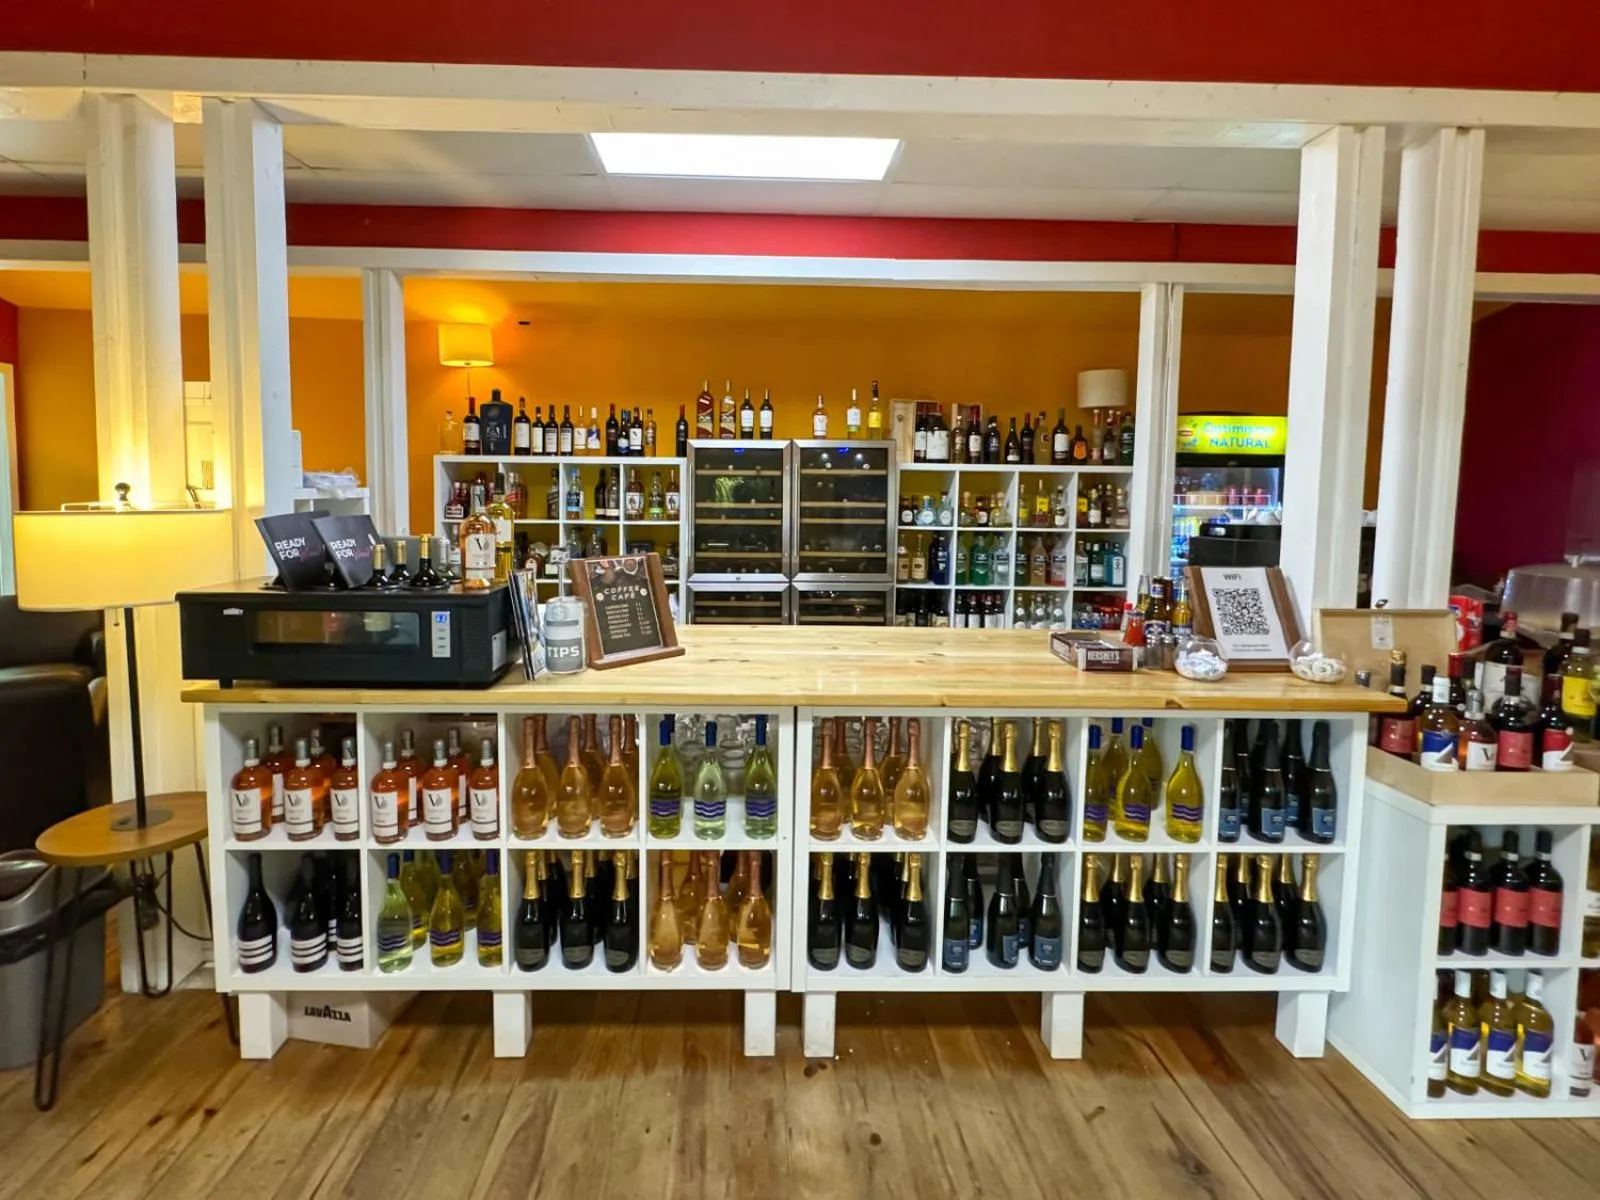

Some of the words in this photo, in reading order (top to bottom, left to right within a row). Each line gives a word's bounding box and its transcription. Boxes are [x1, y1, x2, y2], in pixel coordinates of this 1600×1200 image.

[1210, 437, 1271, 448] NATURAL
[274, 537, 306, 551] READY
[330, 538, 357, 550] READY
[279, 548, 301, 561] FOR
[335, 548, 354, 560] FOR
[604, 585, 640, 595] COFFEE
[547, 645, 580, 658] TIPS
[1087, 650, 1120, 661] HERSHEY'S
